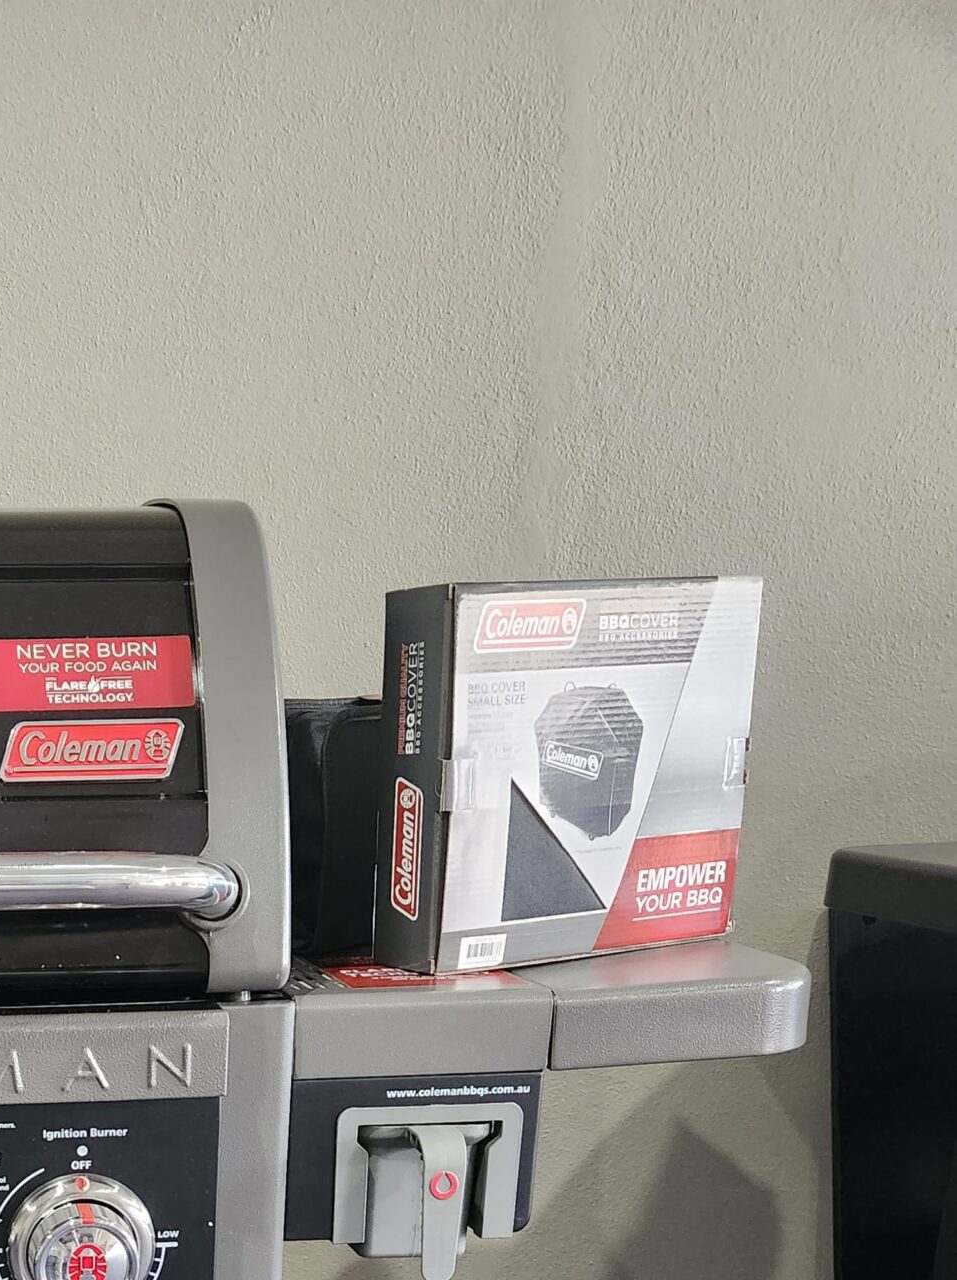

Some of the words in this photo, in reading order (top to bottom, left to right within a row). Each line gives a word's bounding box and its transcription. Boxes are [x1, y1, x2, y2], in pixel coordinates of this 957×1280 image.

[486, 608, 560, 639] Coleman
[600, 613, 679, 629] BBQCOVER
[16, 644, 90, 659] NEVER
[97, 642, 157, 658] BURN
[19, 662, 60, 673] YOUR
[65, 662, 106, 672] FOOD
[112, 660, 157, 671] AGAIN
[46, 681, 87, 691] FLARE
[100, 680, 132, 689] FREE
[468, 683, 489, 694] BBQ
[491, 681, 526, 693] COVER
[47, 693, 132, 704] TECHNOLOGY
[405, 643, 418, 754] BBQCOVER
[468, 696, 501, 707] SMALL
[505, 694, 526, 705] SIZE
[20, 730, 141, 766] Coleman
[547, 744, 587, 769] Coleman
[395, 811, 414, 905] Coleman
[637, 861, 726, 892] EMPOWER
[636, 892, 682, 913] YOUR
[687, 887, 722, 907] BBQ
[387, 1086, 530, 1098] www.colemanbbqs.com.au
[42, 1128, 87, 1140] Ignition
[90, 1128, 128, 1137] Burner
[71, 1160, 92, 1170] OFF
[157, 1230, 179, 1239] LOW
